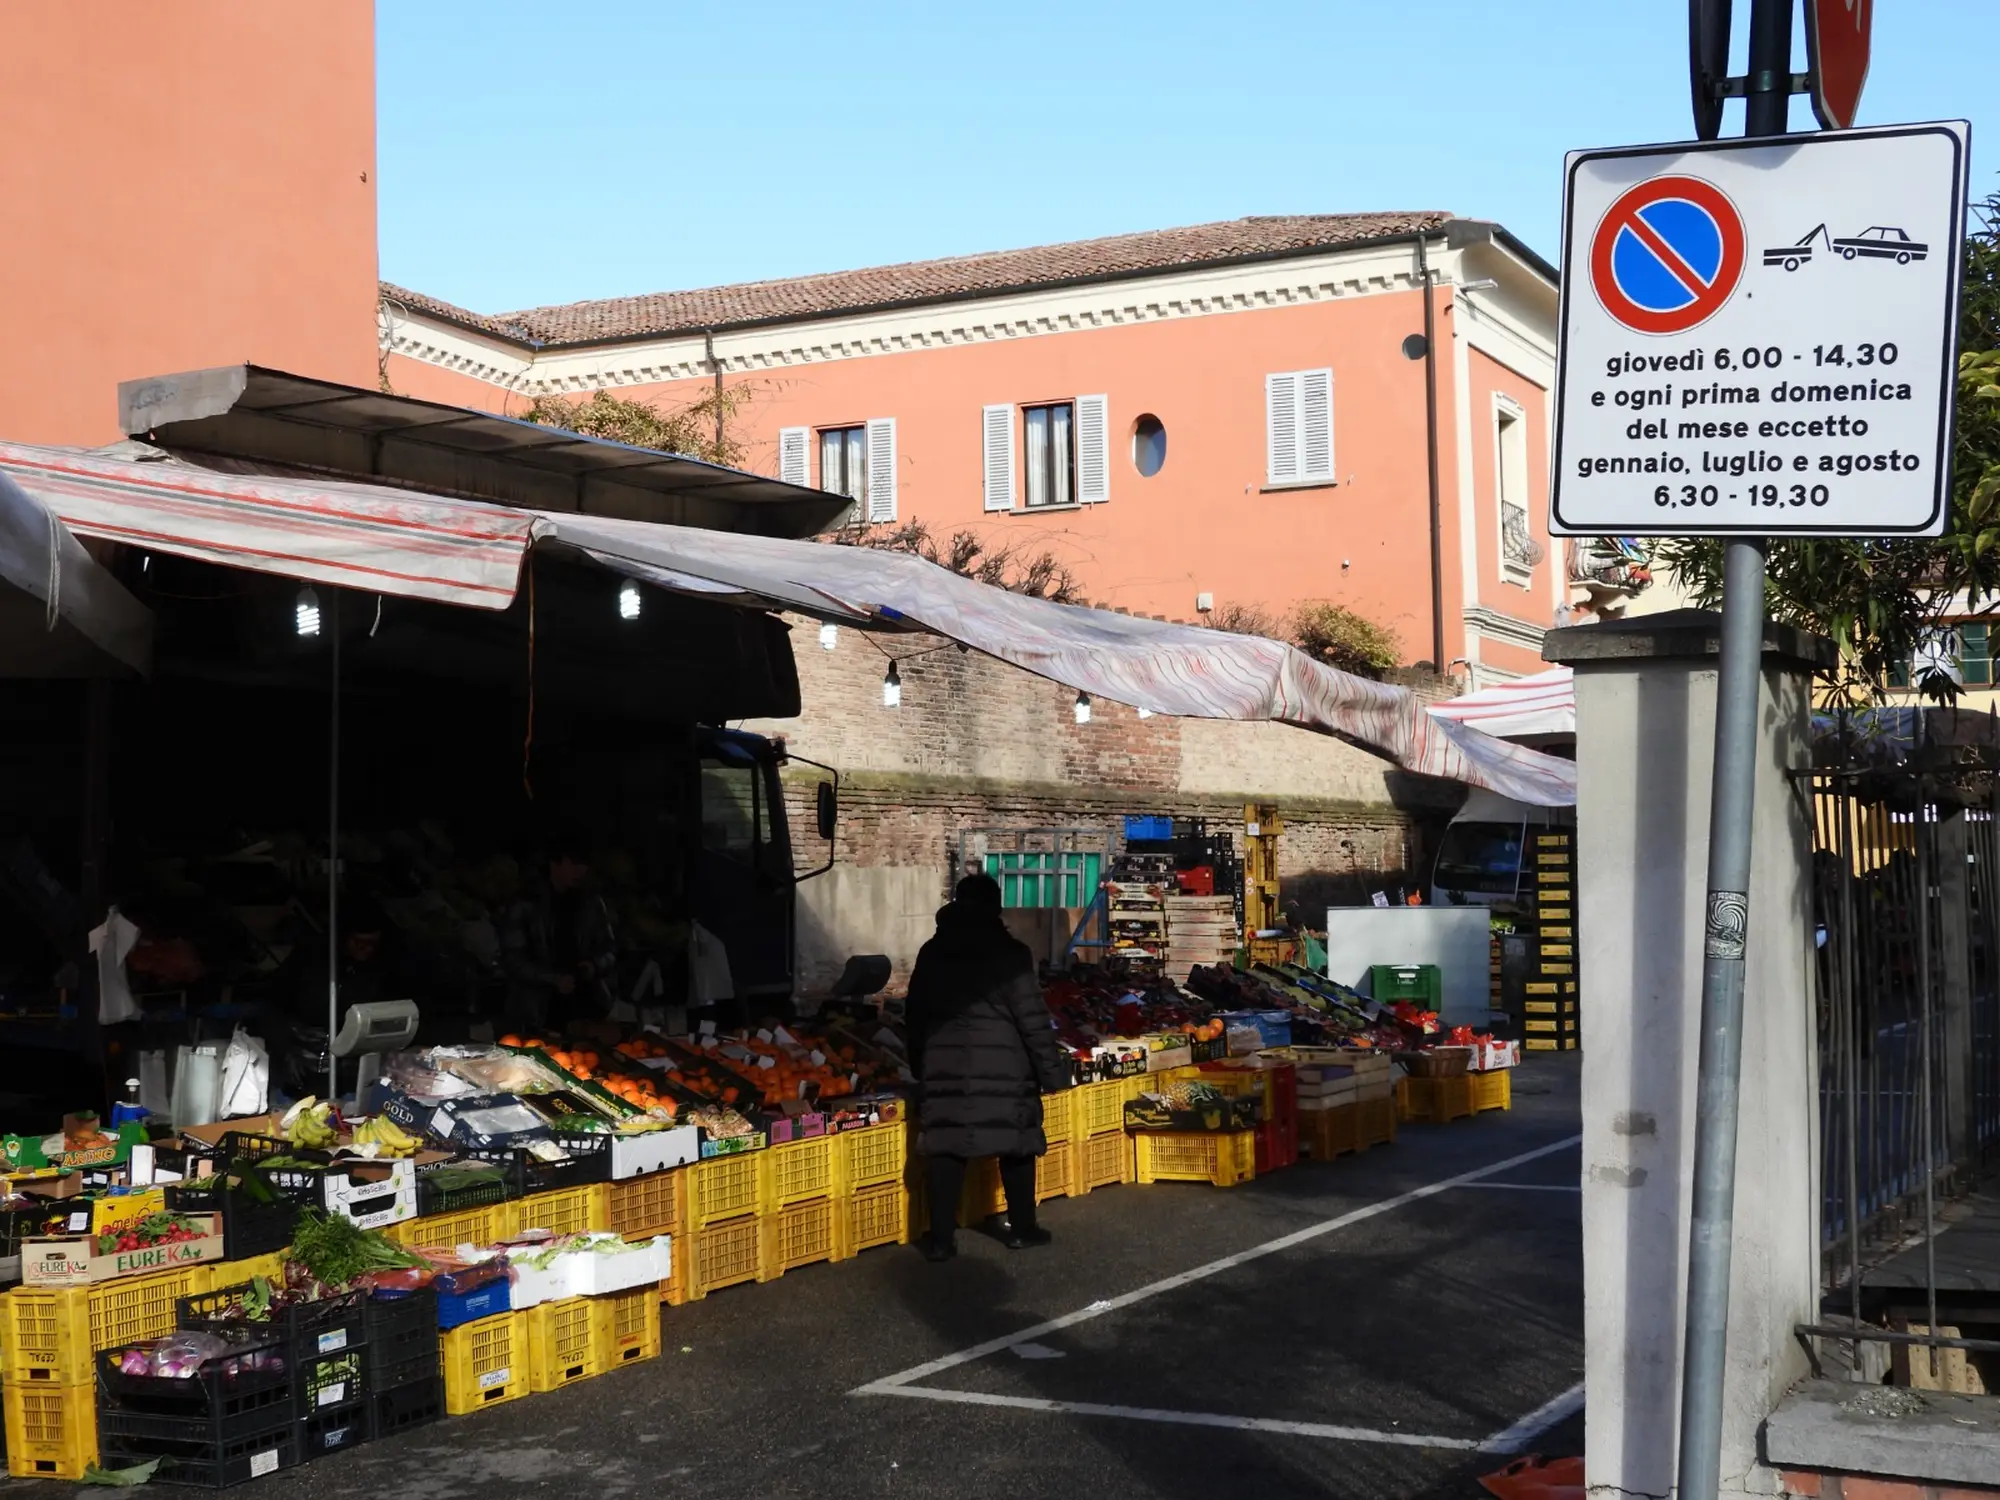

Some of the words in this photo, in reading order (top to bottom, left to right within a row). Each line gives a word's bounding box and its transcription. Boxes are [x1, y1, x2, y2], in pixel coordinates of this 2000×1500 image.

[1606, 347, 1704, 378] giovedì
[1714, 346, 1782, 372] 6,00
[1813, 342, 1898, 369] 14,30
[1591, 391, 1606, 407] e
[1614, 383, 1672, 411] ogni
[1682, 382, 1760, 409] prima
[1770, 378, 1912, 403] domenica
[1626, 418, 1668, 440] del
[1678, 420, 1749, 439] mese
[1758, 414, 1869, 438] eccetto
[1578, 451, 1691, 478] gennaio,
[1702, 449, 1783, 476] luglio
[1792, 454, 1809, 472] e
[1818, 449, 1920, 477] agosto
[1654, 484, 1719, 509] 6,30
[1748, 482, 1829, 509] 19,30
[383, 1101, 414, 1124] GOLD
[40, 1261, 81, 1273] EUREKA
[117, 1244, 193, 1273] EUREKA
